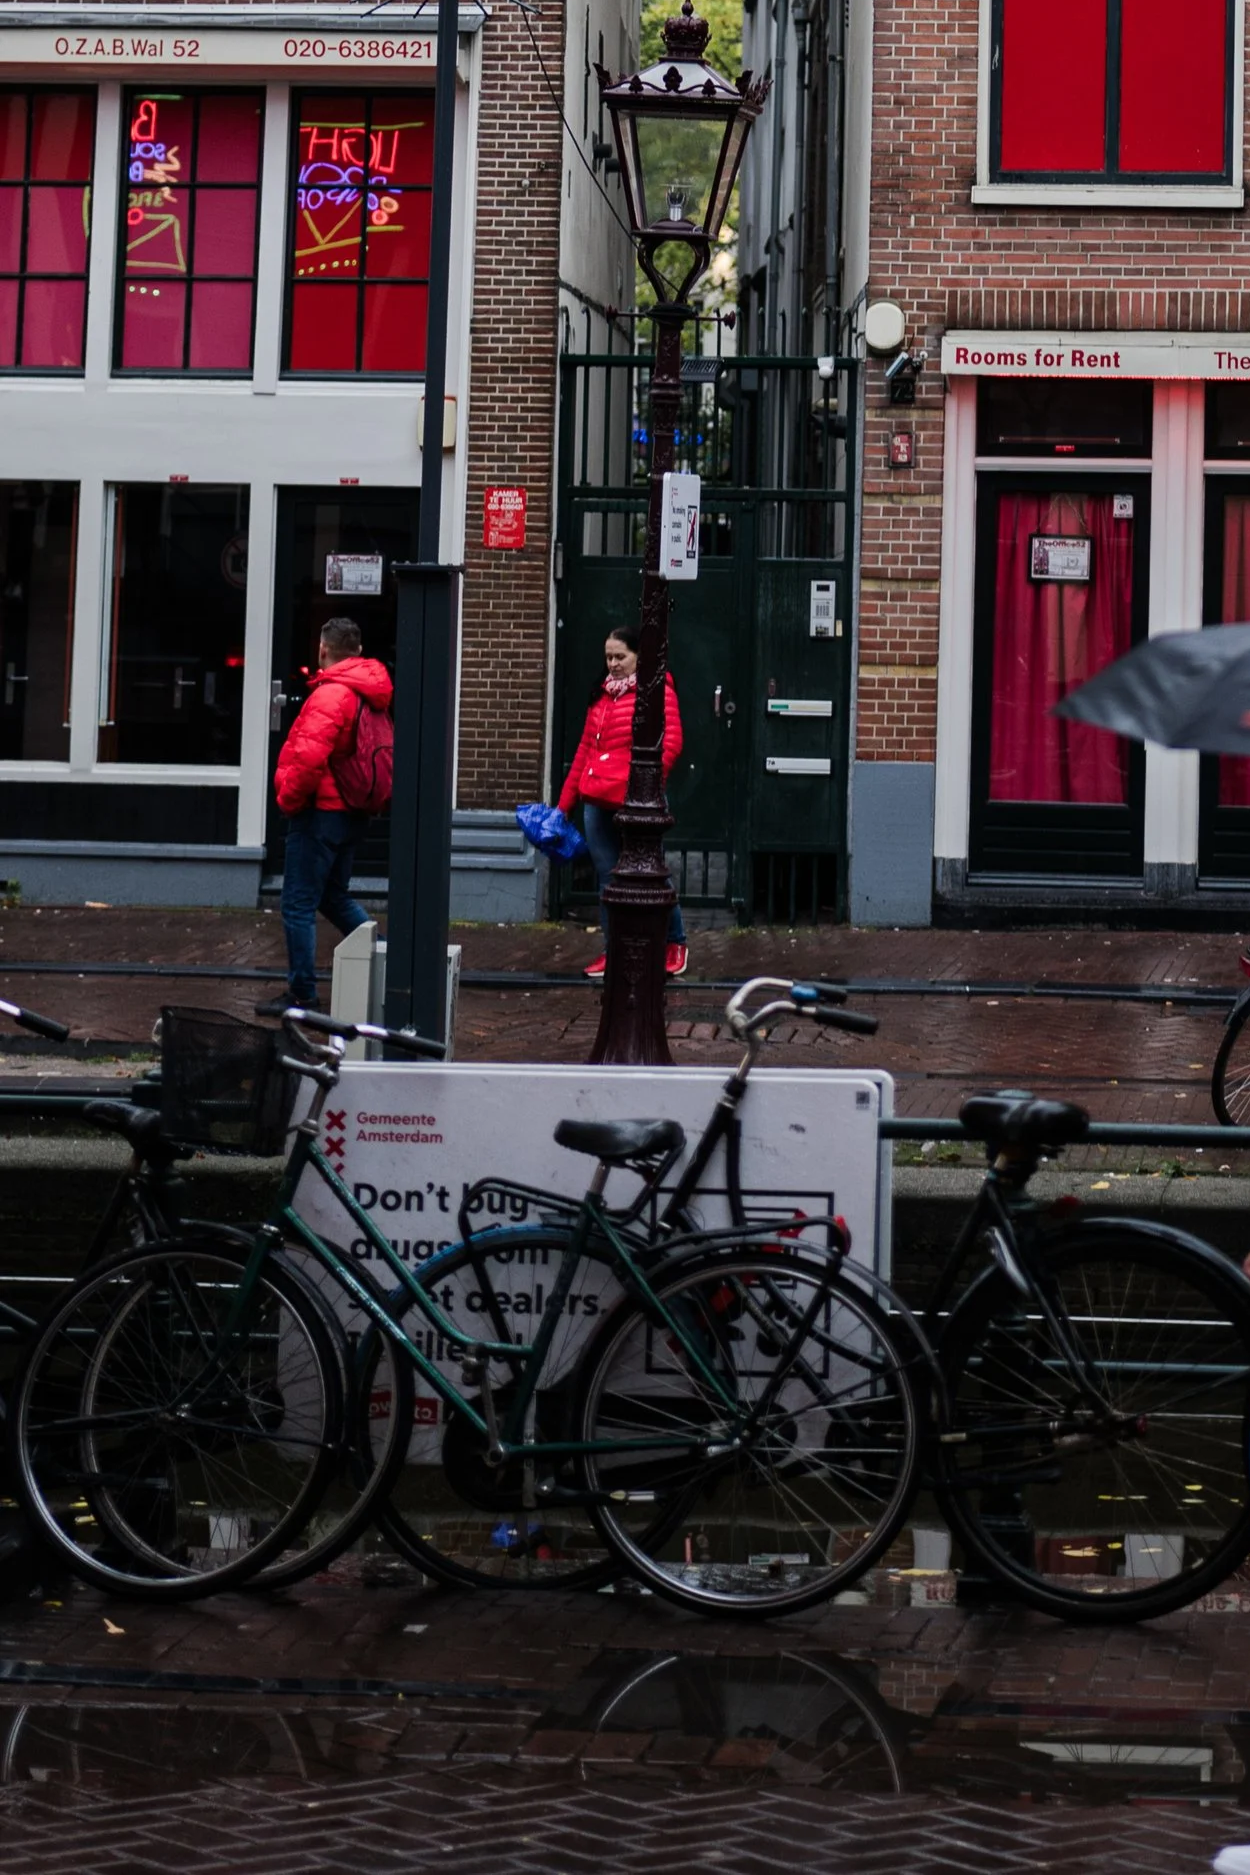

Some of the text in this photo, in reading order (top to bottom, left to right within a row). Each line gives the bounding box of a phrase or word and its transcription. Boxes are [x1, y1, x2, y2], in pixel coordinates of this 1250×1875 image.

[55, 37, 200, 57] O.Z.A.B.Wal 52
[283, 39, 432, 59] 020-6386421
[955, 347, 1121, 368] Rooms for Rent
[356, 1111, 436, 1126] Gemeente
[356, 1129, 443, 1144] Amsterdam
[354, 1182, 450, 1213] Don't
